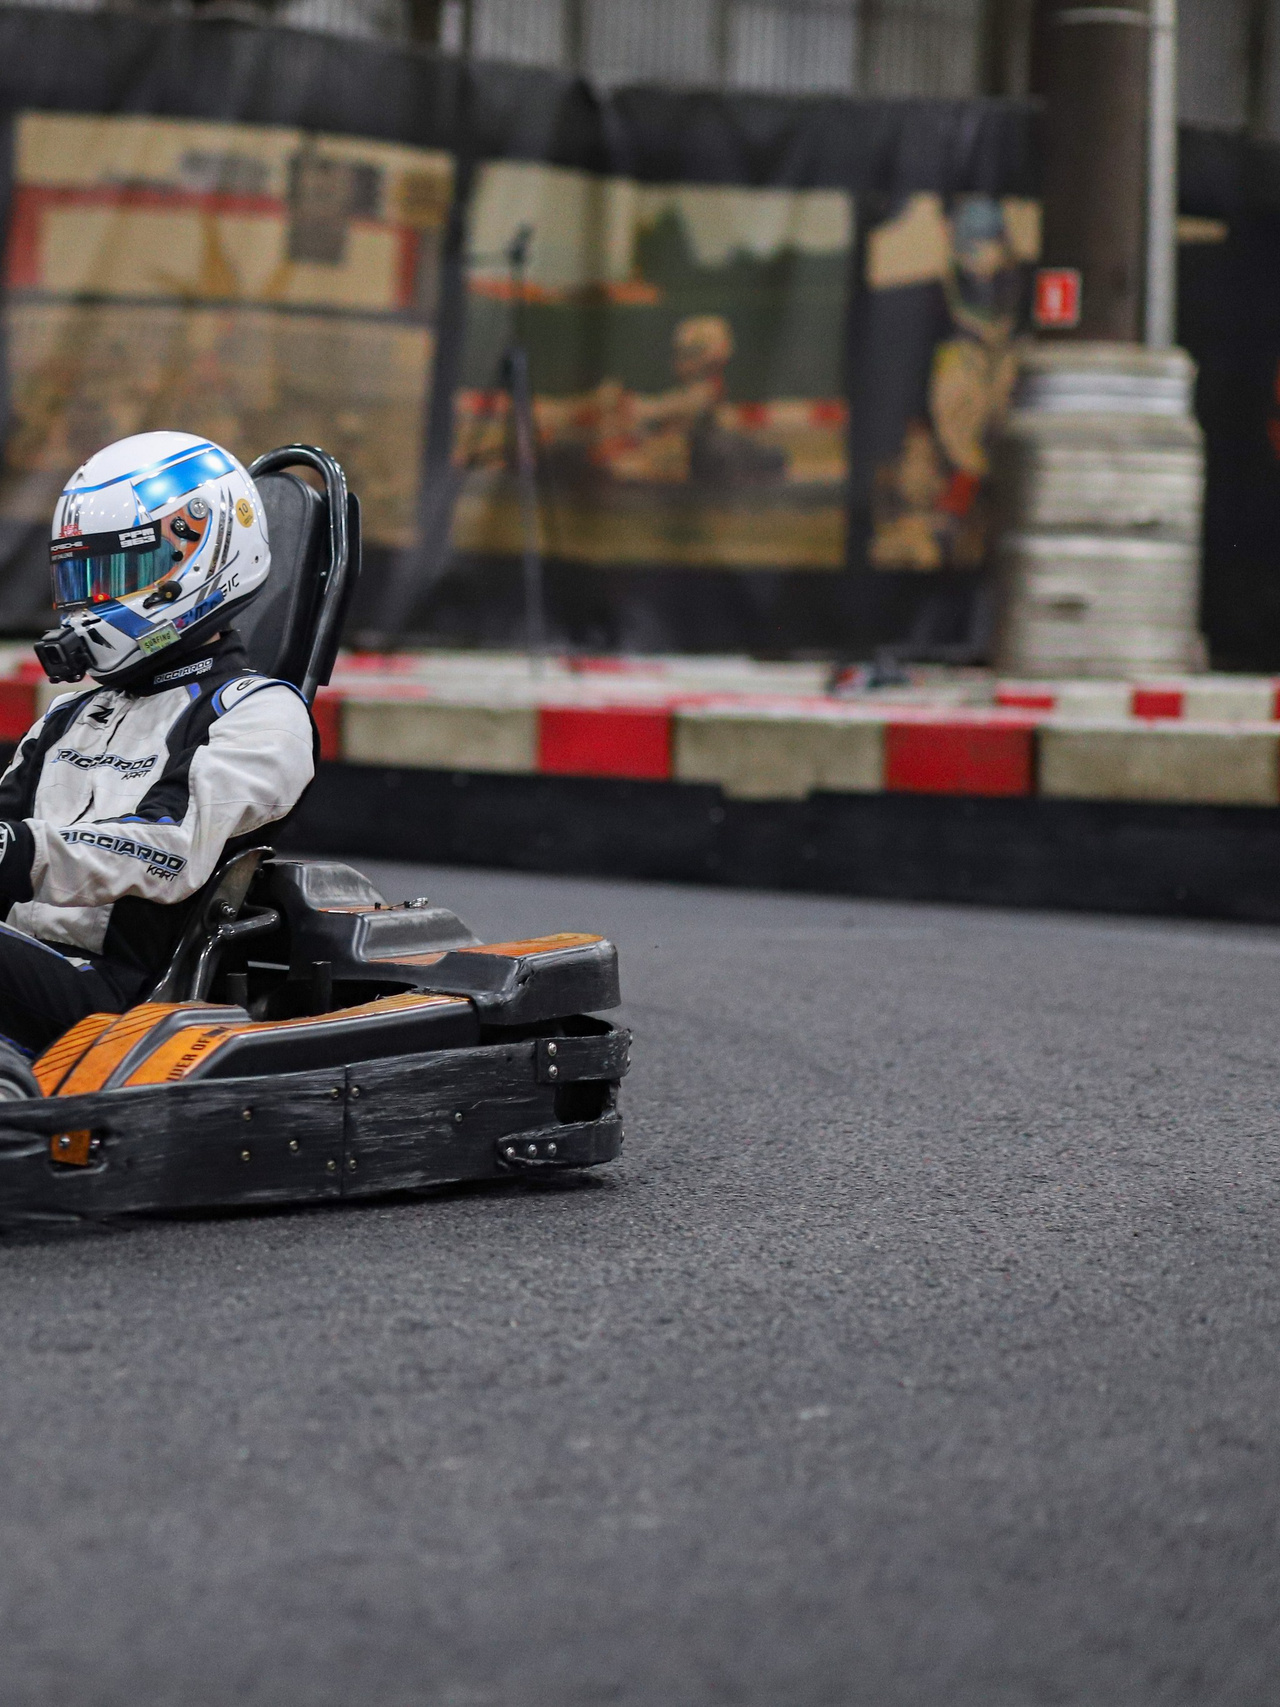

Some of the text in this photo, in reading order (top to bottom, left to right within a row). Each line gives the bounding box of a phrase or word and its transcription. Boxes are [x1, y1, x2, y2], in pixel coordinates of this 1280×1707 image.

[58, 749, 158, 771] RICARDO
[121, 769, 152, 781] KART
[59, 830, 187, 873] RICCIARDO
[146, 864, 178, 881] KART
